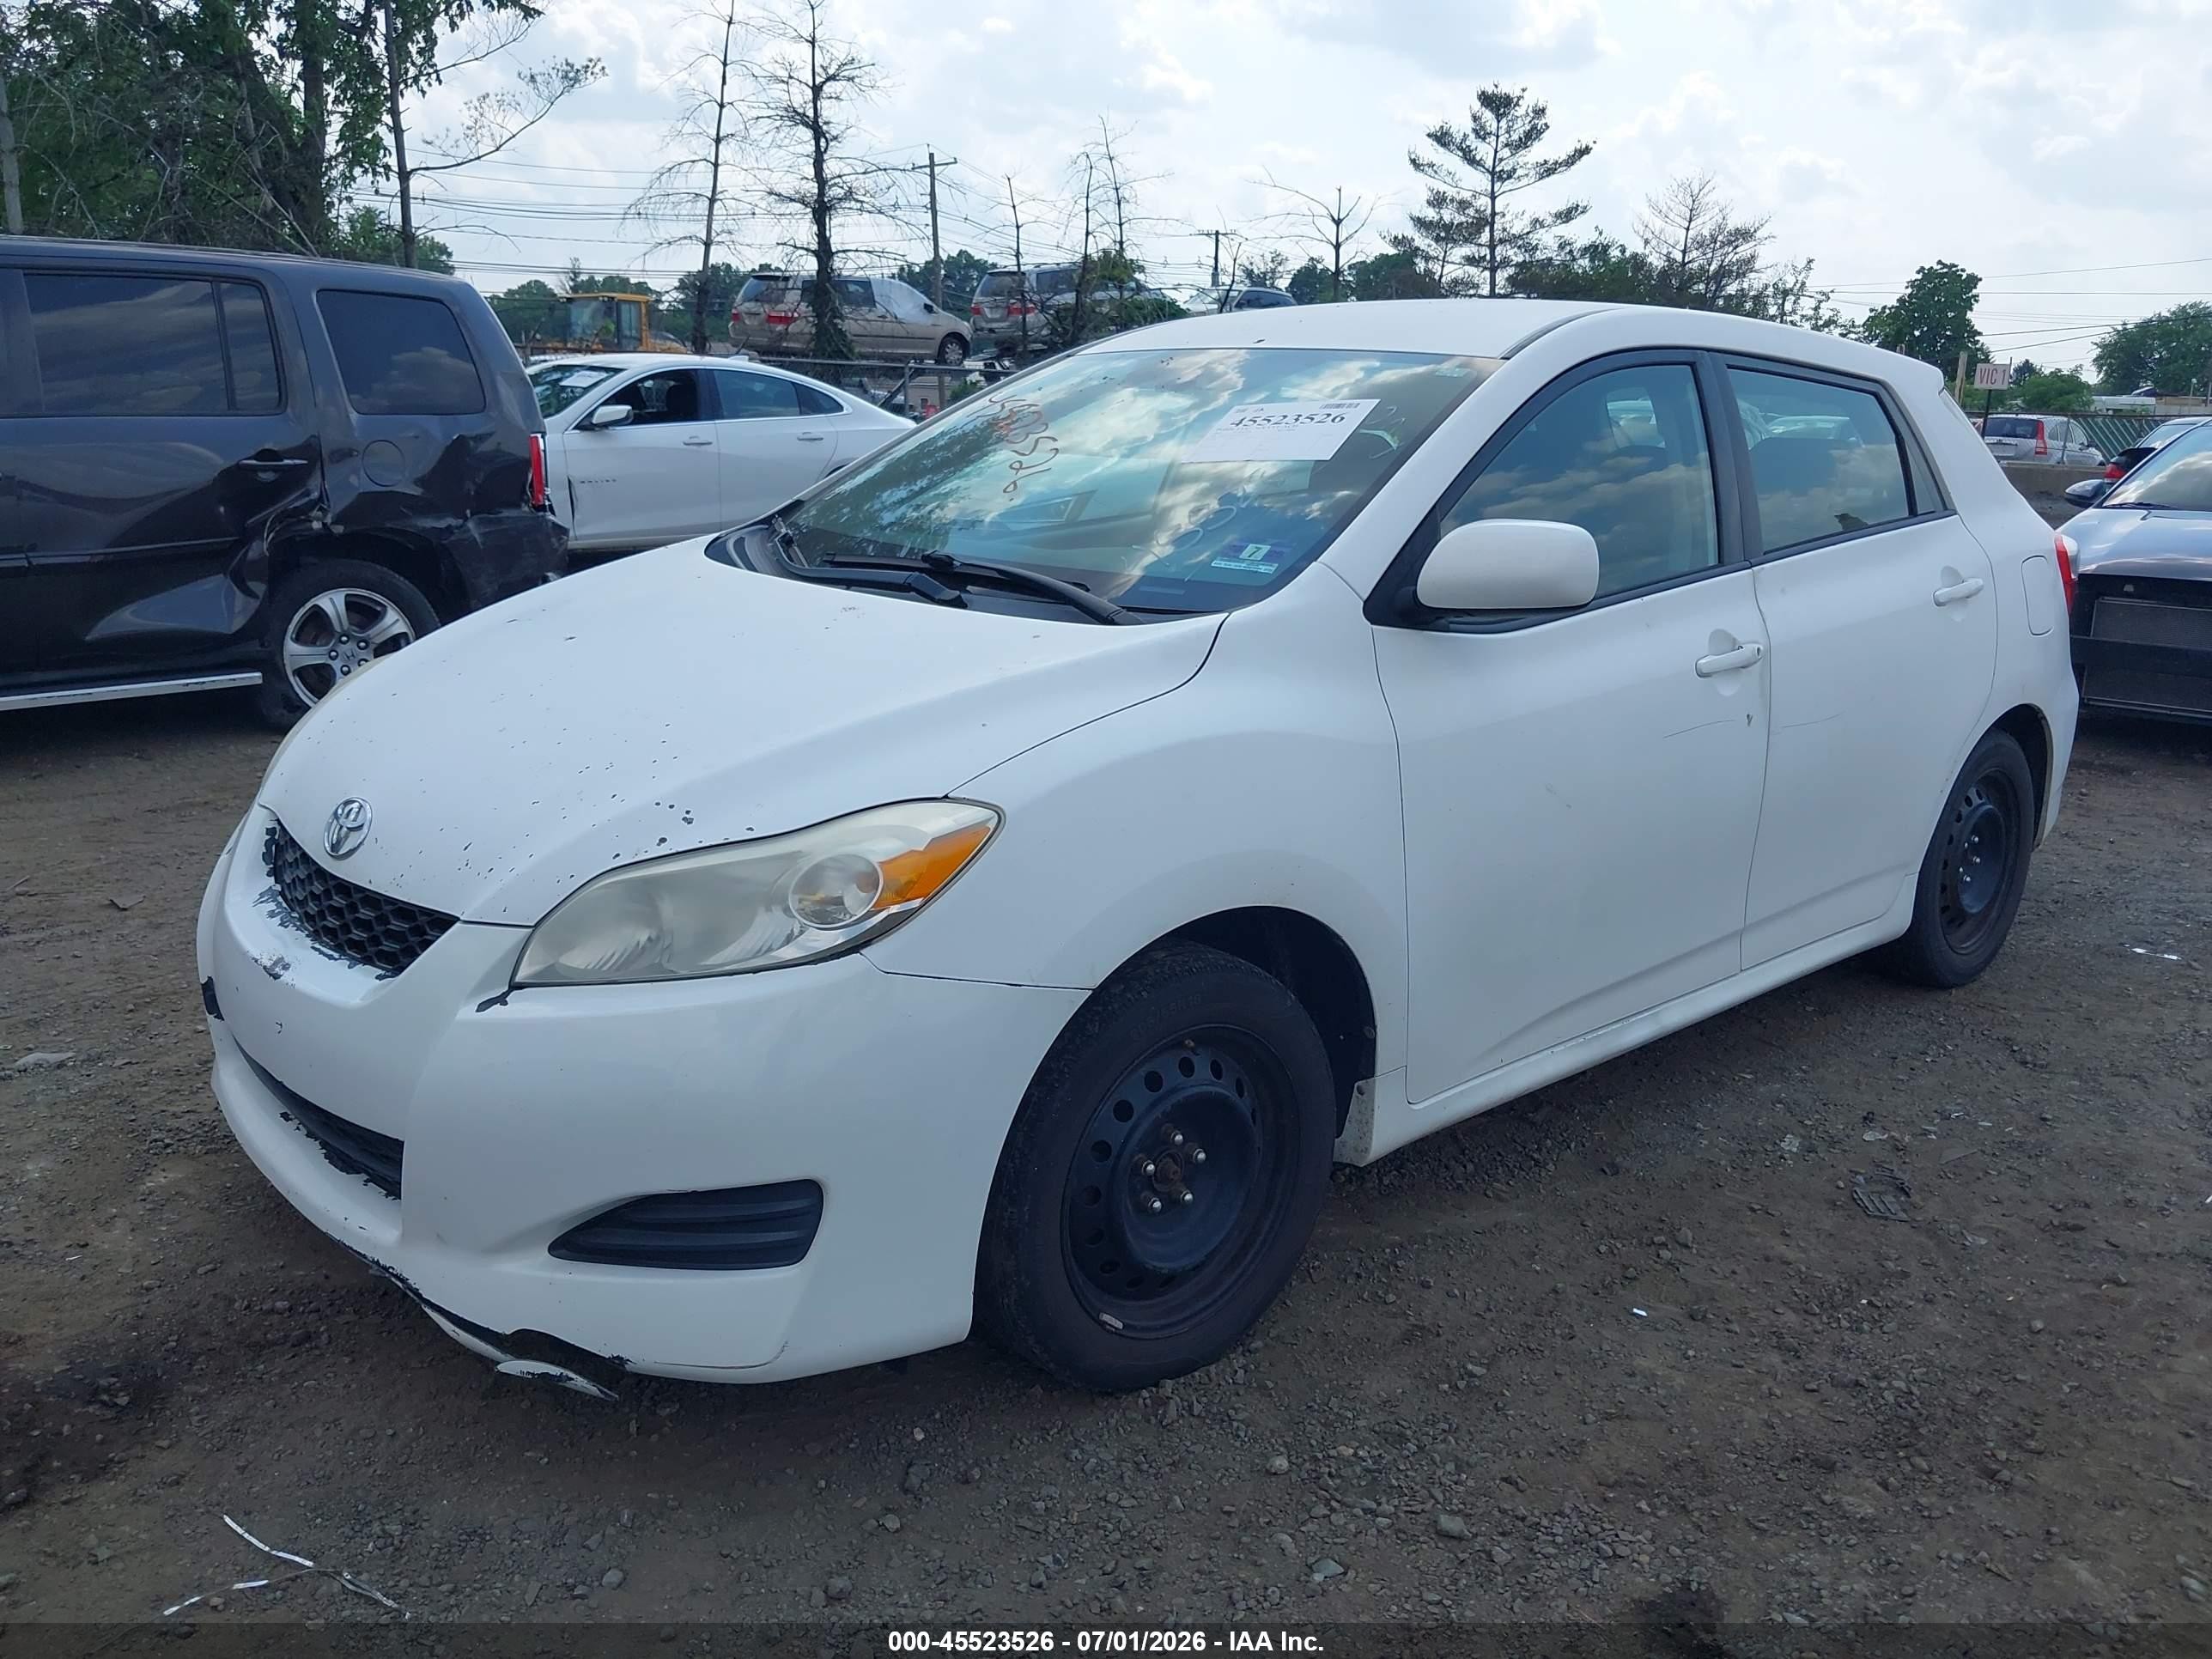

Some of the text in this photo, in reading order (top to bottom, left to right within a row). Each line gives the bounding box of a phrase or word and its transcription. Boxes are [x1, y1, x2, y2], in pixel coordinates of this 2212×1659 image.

[1978, 368, 2007, 385] VIC 1
[1230, 412, 1346, 427] 45523526
[1248, 547, 1261, 557] 7
